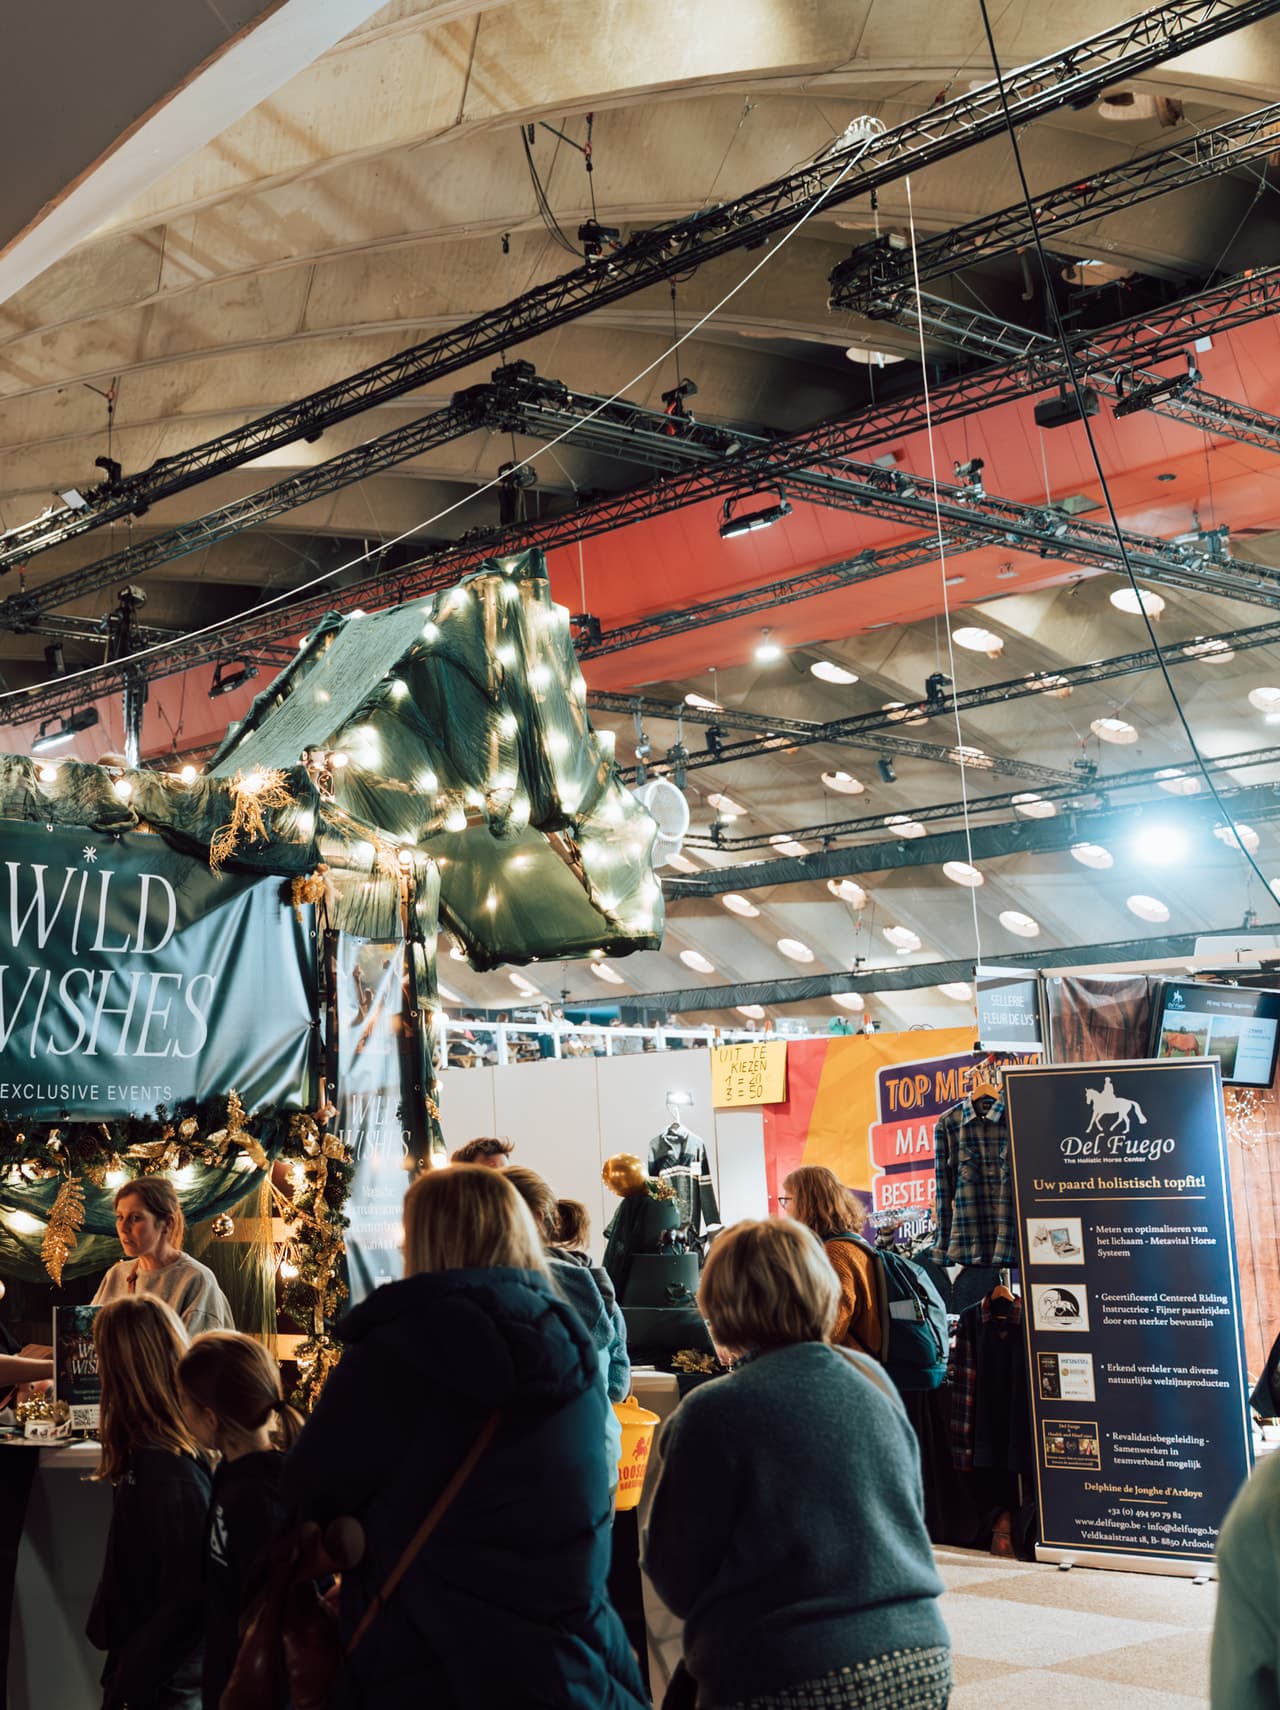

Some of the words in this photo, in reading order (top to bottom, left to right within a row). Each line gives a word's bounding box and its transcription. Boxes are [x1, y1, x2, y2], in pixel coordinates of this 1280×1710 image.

[991, 994, 1025, 1007] SELLERIE
[983, 1012, 1008, 1025] FLEUR
[1009, 1012, 1020, 1025] DE
[1021, 1013, 1034, 1026] LYS
[720, 1047, 742, 1062] UIT
[752, 1045, 767, 1060] TE
[731, 1060, 767, 1074] KIEZEN
[725, 1075, 732, 1087] 1
[749, 1072, 762, 1086] 20
[0, 1083, 99, 1100] EXCLUSIVE
[107, 1084, 172, 1101] EVENTS
[726, 1087, 733, 1101] 3
[749, 1084, 763, 1099] 50
[886, 1074, 931, 1111] TOP
[895, 1124, 936, 1156] MA
[1060, 1133, 1105, 1156] Del
[1107, 1135, 1176, 1161] Fuego
[1033, 1179, 1056, 1191] Uw
[1059, 1177, 1095, 1193] paard
[1098, 1175, 1163, 1190] holistisch
[1164, 1175, 1206, 1191] topfit!
[882, 1180, 925, 1206] BESTE
[1096, 1225, 1122, 1234] Meten
[1123, 1226, 1133, 1234] en
[1135, 1225, 1191, 1235] optimaliseren
[1096, 1237, 1110, 1245] het
[1111, 1237, 1144, 1245] lichaam
[1150, 1236, 1189, 1245] Metavital
[1191, 1237, 1217, 1245] Horse
[1097, 1249, 1131, 1259] Systeem
[1101, 1293, 1158, 1302] Gecertificeerd
[1159, 1294, 1198, 1302] Centered
[1199, 1294, 1228, 1304] Riding
[1102, 1305, 1149, 1313] Instructrice
[1156, 1306, 1180, 1315] Fijner
[1182, 1306, 1230, 1316] paardrijden
[1103, 1317, 1122, 1325] door
[1139, 1317, 1169, 1326] sterker
[1170, 1318, 1214, 1328] bewustzijn
[72, 1359, 99, 1376] WIS
[1107, 1364, 1136, 1373] Erkend
[1137, 1364, 1171, 1374] verdeler
[1189, 1366, 1219, 1375] diverse
[1108, 1376, 1152, 1386] natuurlijke
[1154, 1377, 1230, 1388] welzijnsproducten
[1112, 1432, 1205, 1446] Revalidatiebegeleiding
[1113, 1445, 1169, 1455] Samenwerken
[1170, 1447, 1179, 1455] in
[1113, 1456, 1165, 1466] teamverband
[1166, 1460, 1201, 1470] mogelijk
[1084, 1482, 1122, 1493] Delphine
[1123, 1485, 1133, 1493] de
[1134, 1485, 1163, 1497] Jonghe
[1165, 1487, 1203, 1499] d'Ardoye
[1135, 1510, 1149, 1519] 494
[1161, 1511, 1171, 1520] 79
[1075, 1518, 1141, 1530] www.delfuego.be
[1147, 1522, 1219, 1536] info@delfuego.be
[1181, 1539, 1215, 1549] Ardooie
